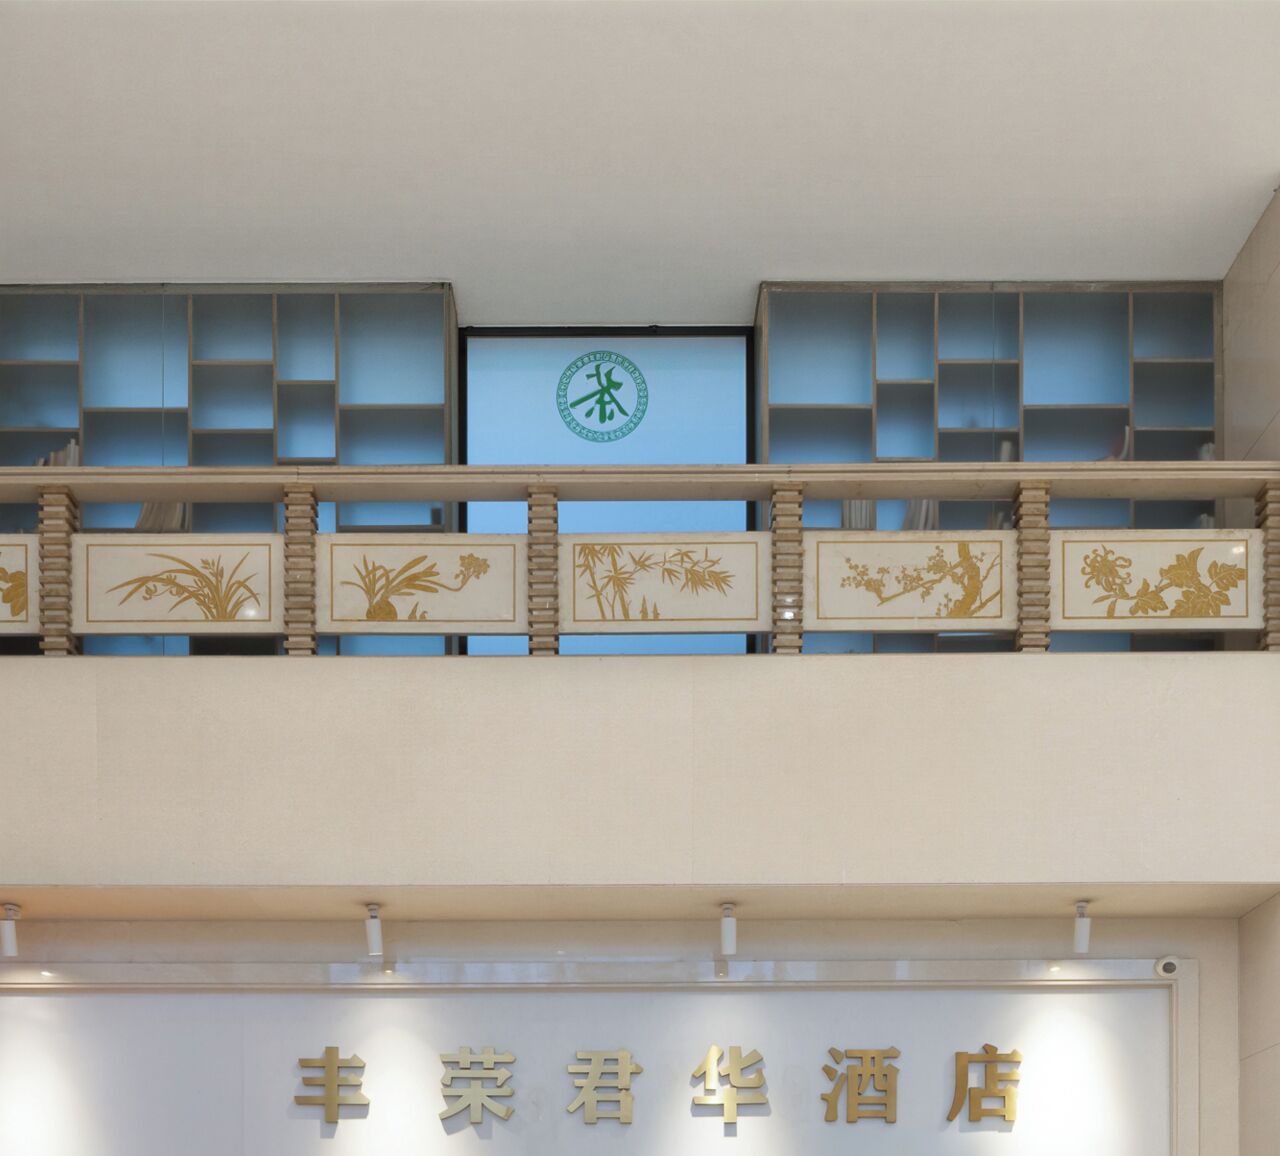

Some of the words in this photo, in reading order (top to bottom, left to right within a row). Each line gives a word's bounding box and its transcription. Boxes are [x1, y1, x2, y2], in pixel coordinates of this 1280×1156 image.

[293, 1042, 1024, 1125] 丰荣君华酒店
